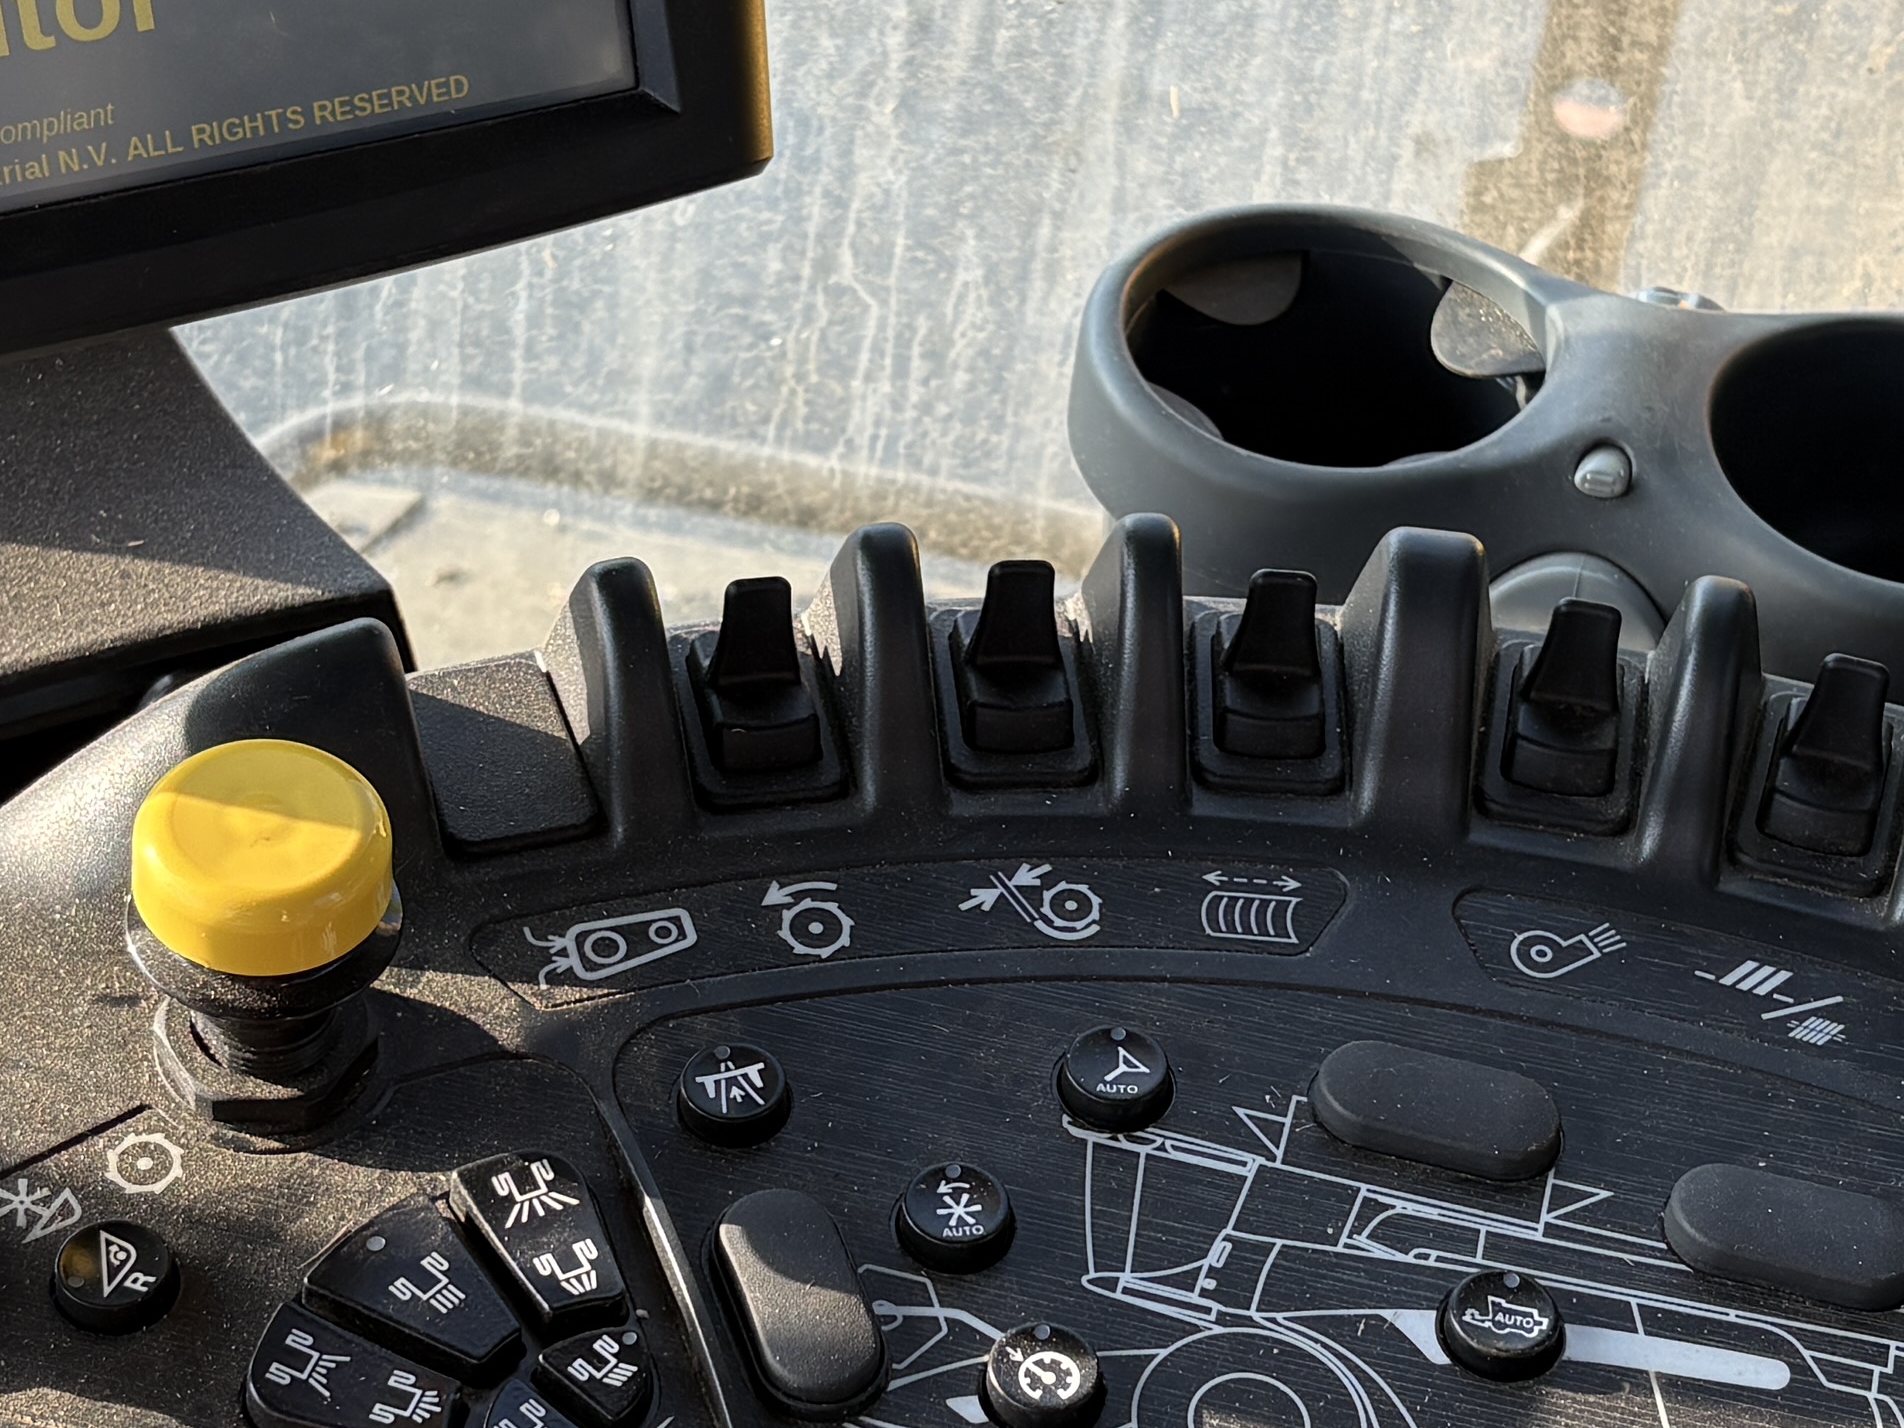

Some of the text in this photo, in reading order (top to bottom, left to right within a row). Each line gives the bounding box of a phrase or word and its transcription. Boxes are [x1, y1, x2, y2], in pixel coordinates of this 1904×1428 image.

[58, 142, 117, 175] N.V.
[127, 129, 184, 162] ALL
[191, 106, 306, 149] RIGHTS
[313, 74, 470, 125] RESERVED
[1096, 1083, 1138, 1094] AUTO
[942, 1224, 984, 1237] AUTO
[123, 1272, 157, 1292] R
[1495, 1312, 1534, 1328] AUTO
